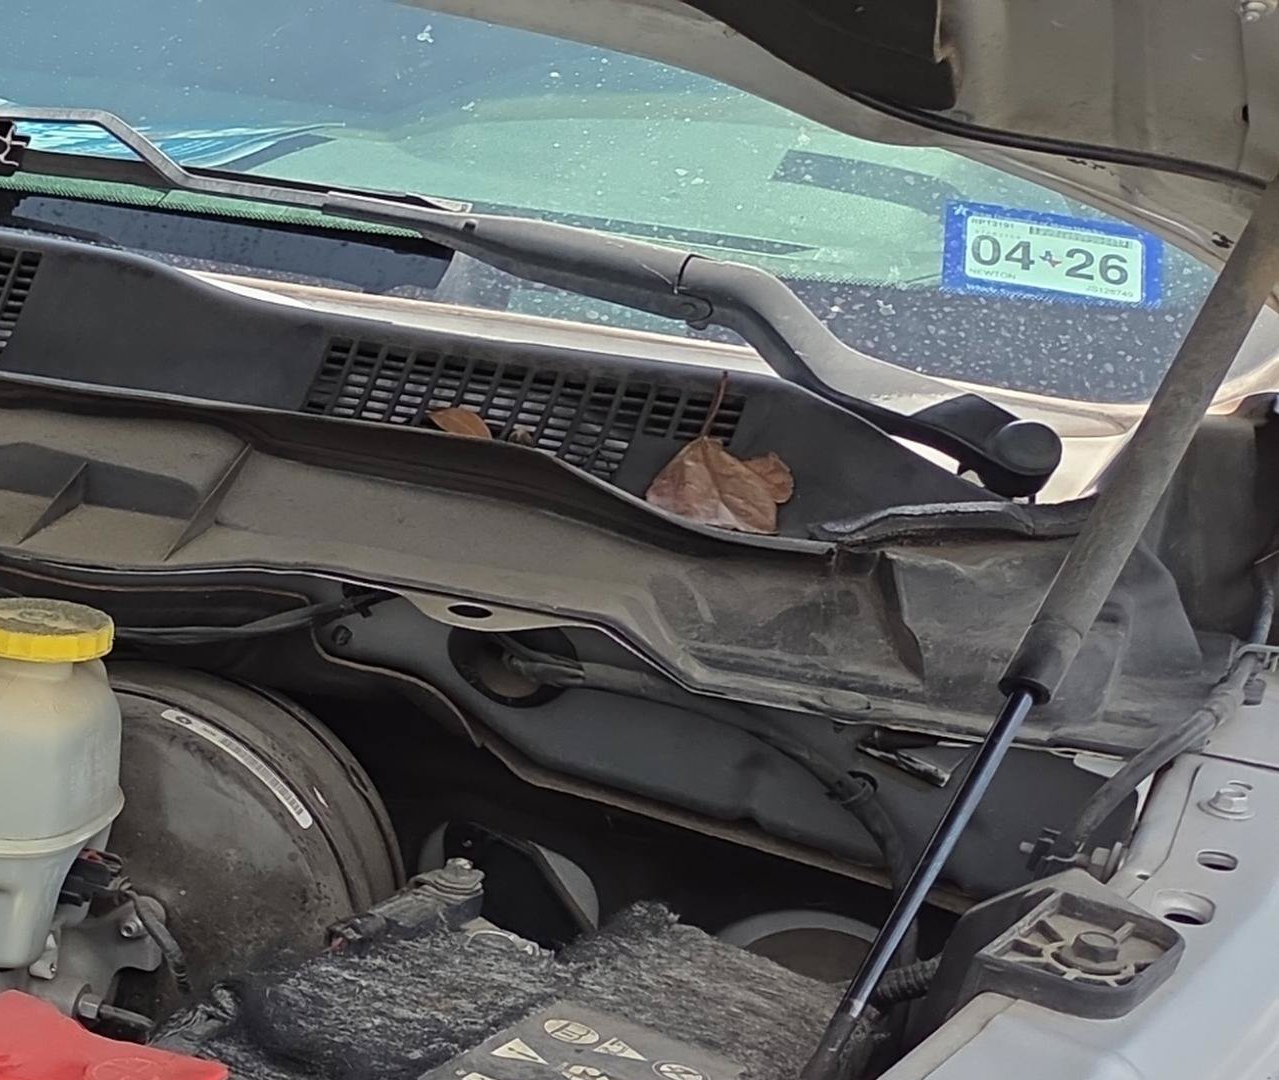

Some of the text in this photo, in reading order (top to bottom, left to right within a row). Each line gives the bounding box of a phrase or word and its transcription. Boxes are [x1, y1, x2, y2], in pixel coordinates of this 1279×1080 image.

[968, 267, 1017, 280] NEWTON
[970, 234, 1129, 286] 04 26
